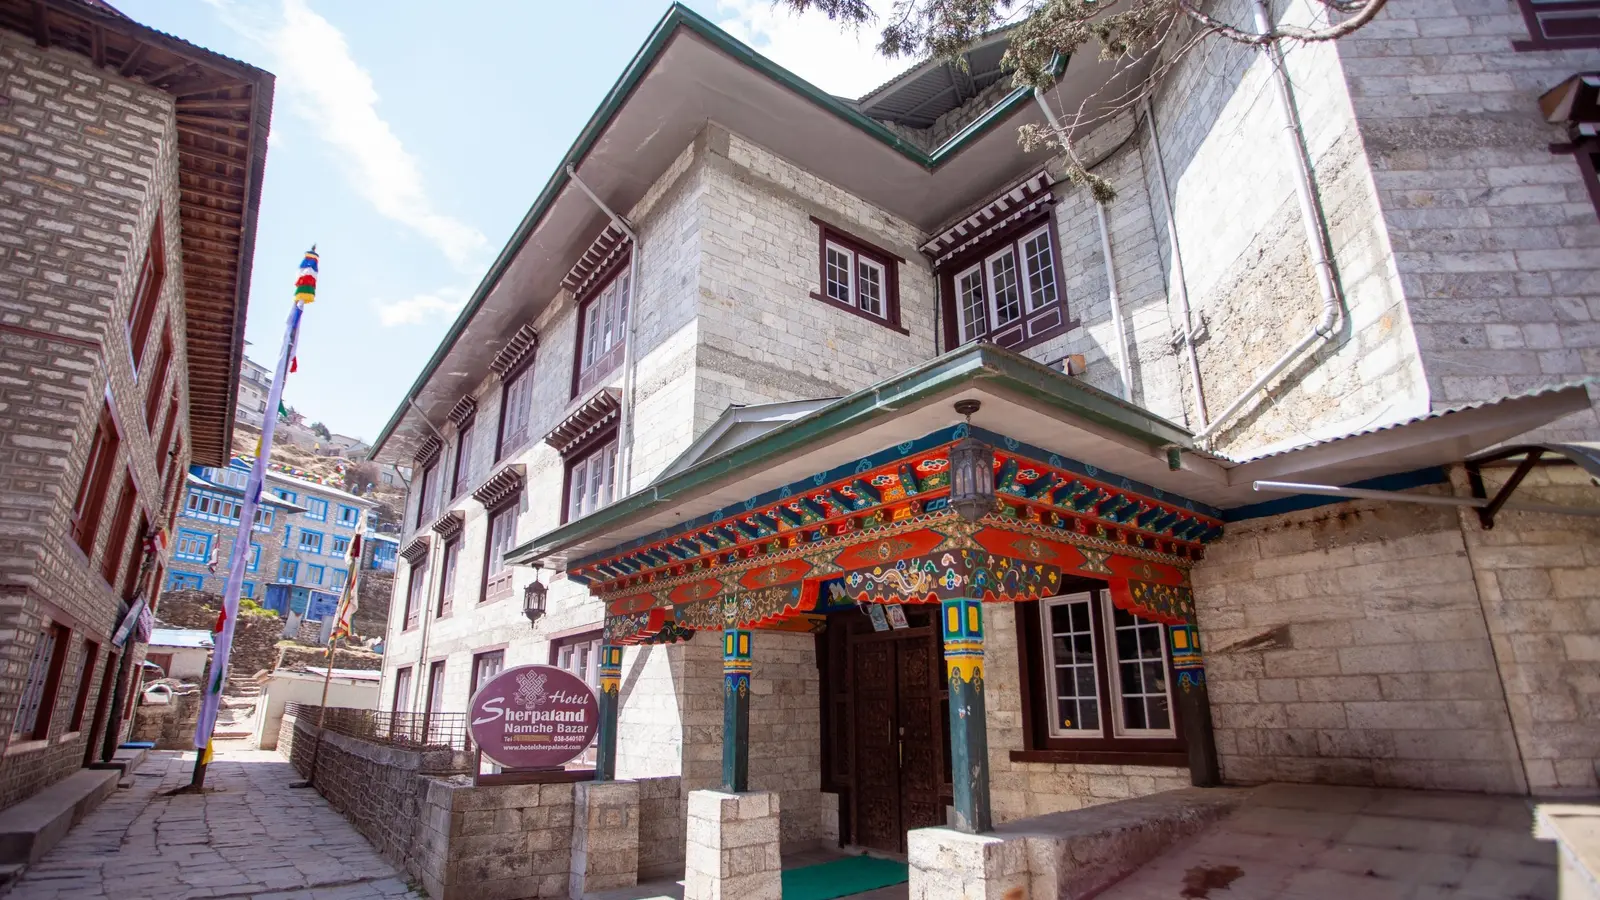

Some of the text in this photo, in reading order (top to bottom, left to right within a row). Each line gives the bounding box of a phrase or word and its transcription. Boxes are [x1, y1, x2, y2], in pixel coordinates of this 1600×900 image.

[549, 690, 589, 705] Hotel
[472, 697, 585, 725] Sherpaland
[504, 723, 589, 733] Namche Bazar
